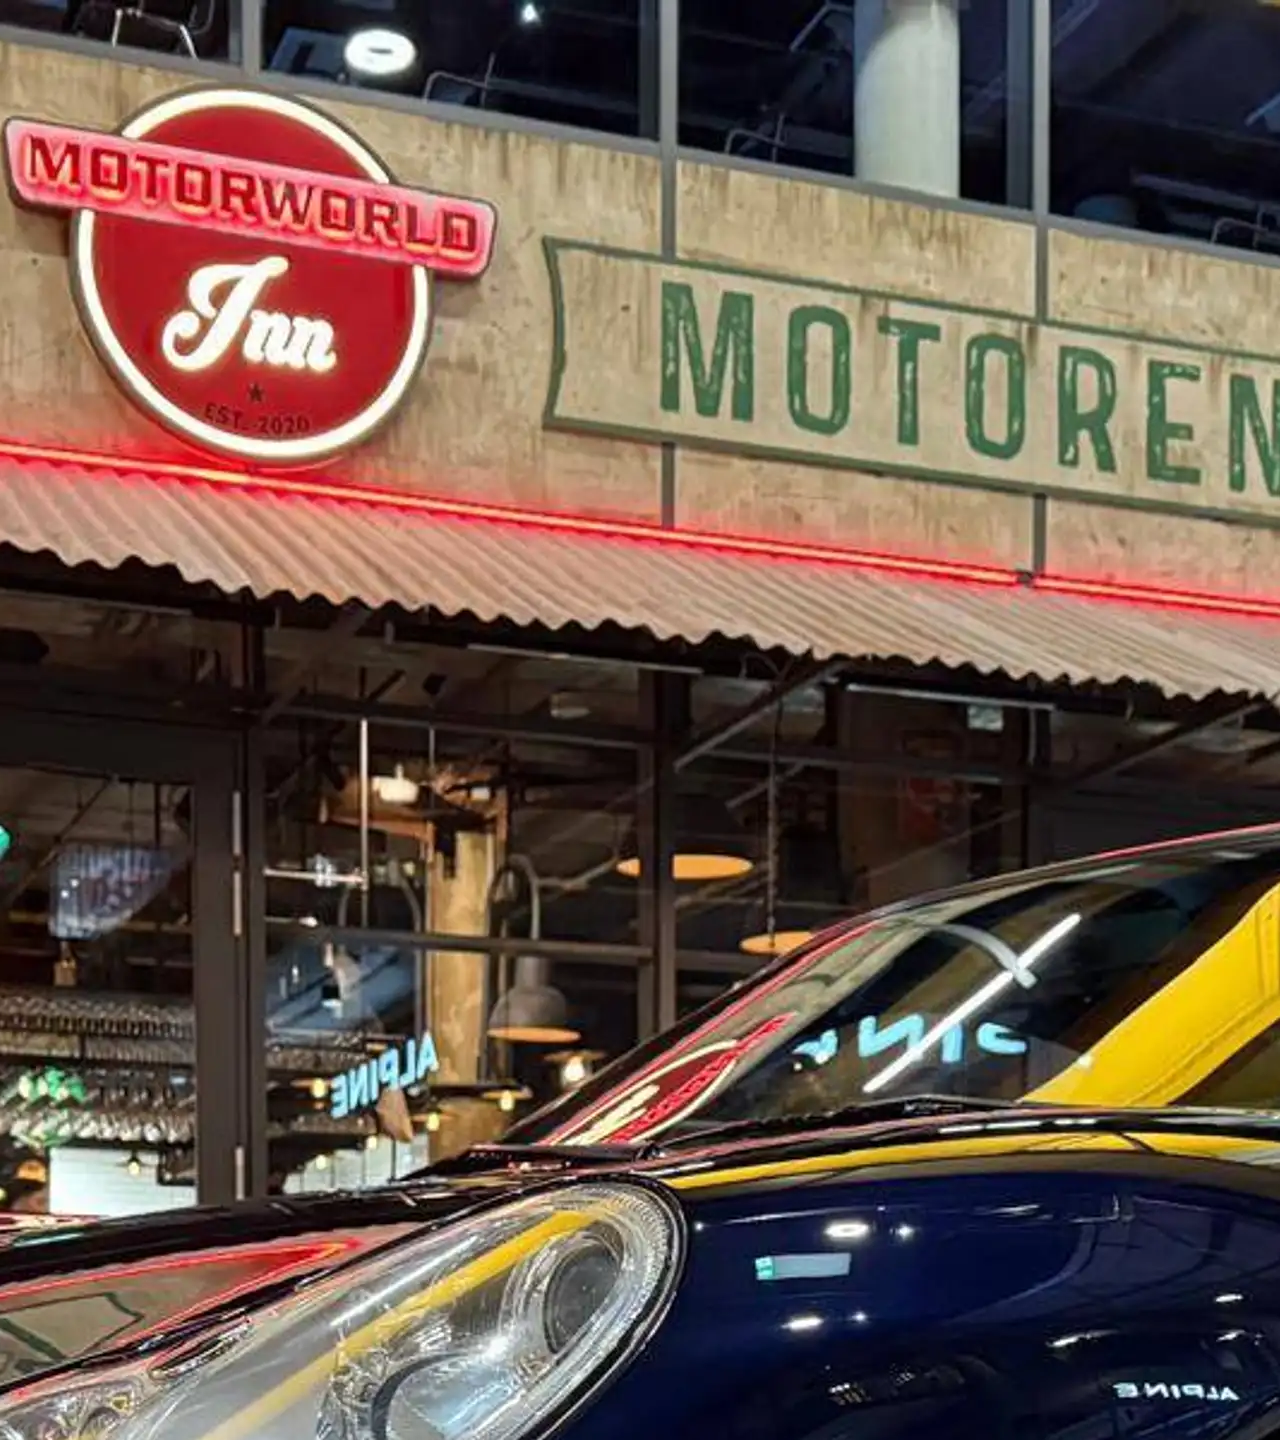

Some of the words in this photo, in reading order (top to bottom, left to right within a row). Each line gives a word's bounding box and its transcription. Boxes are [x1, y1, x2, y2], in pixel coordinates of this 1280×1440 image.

[26, 135, 478, 256] MOTORWORLD
[161, 255, 339, 373] Inn
[204, 402, 249, 431] EST.
[258, 414, 311, 435] 2020
